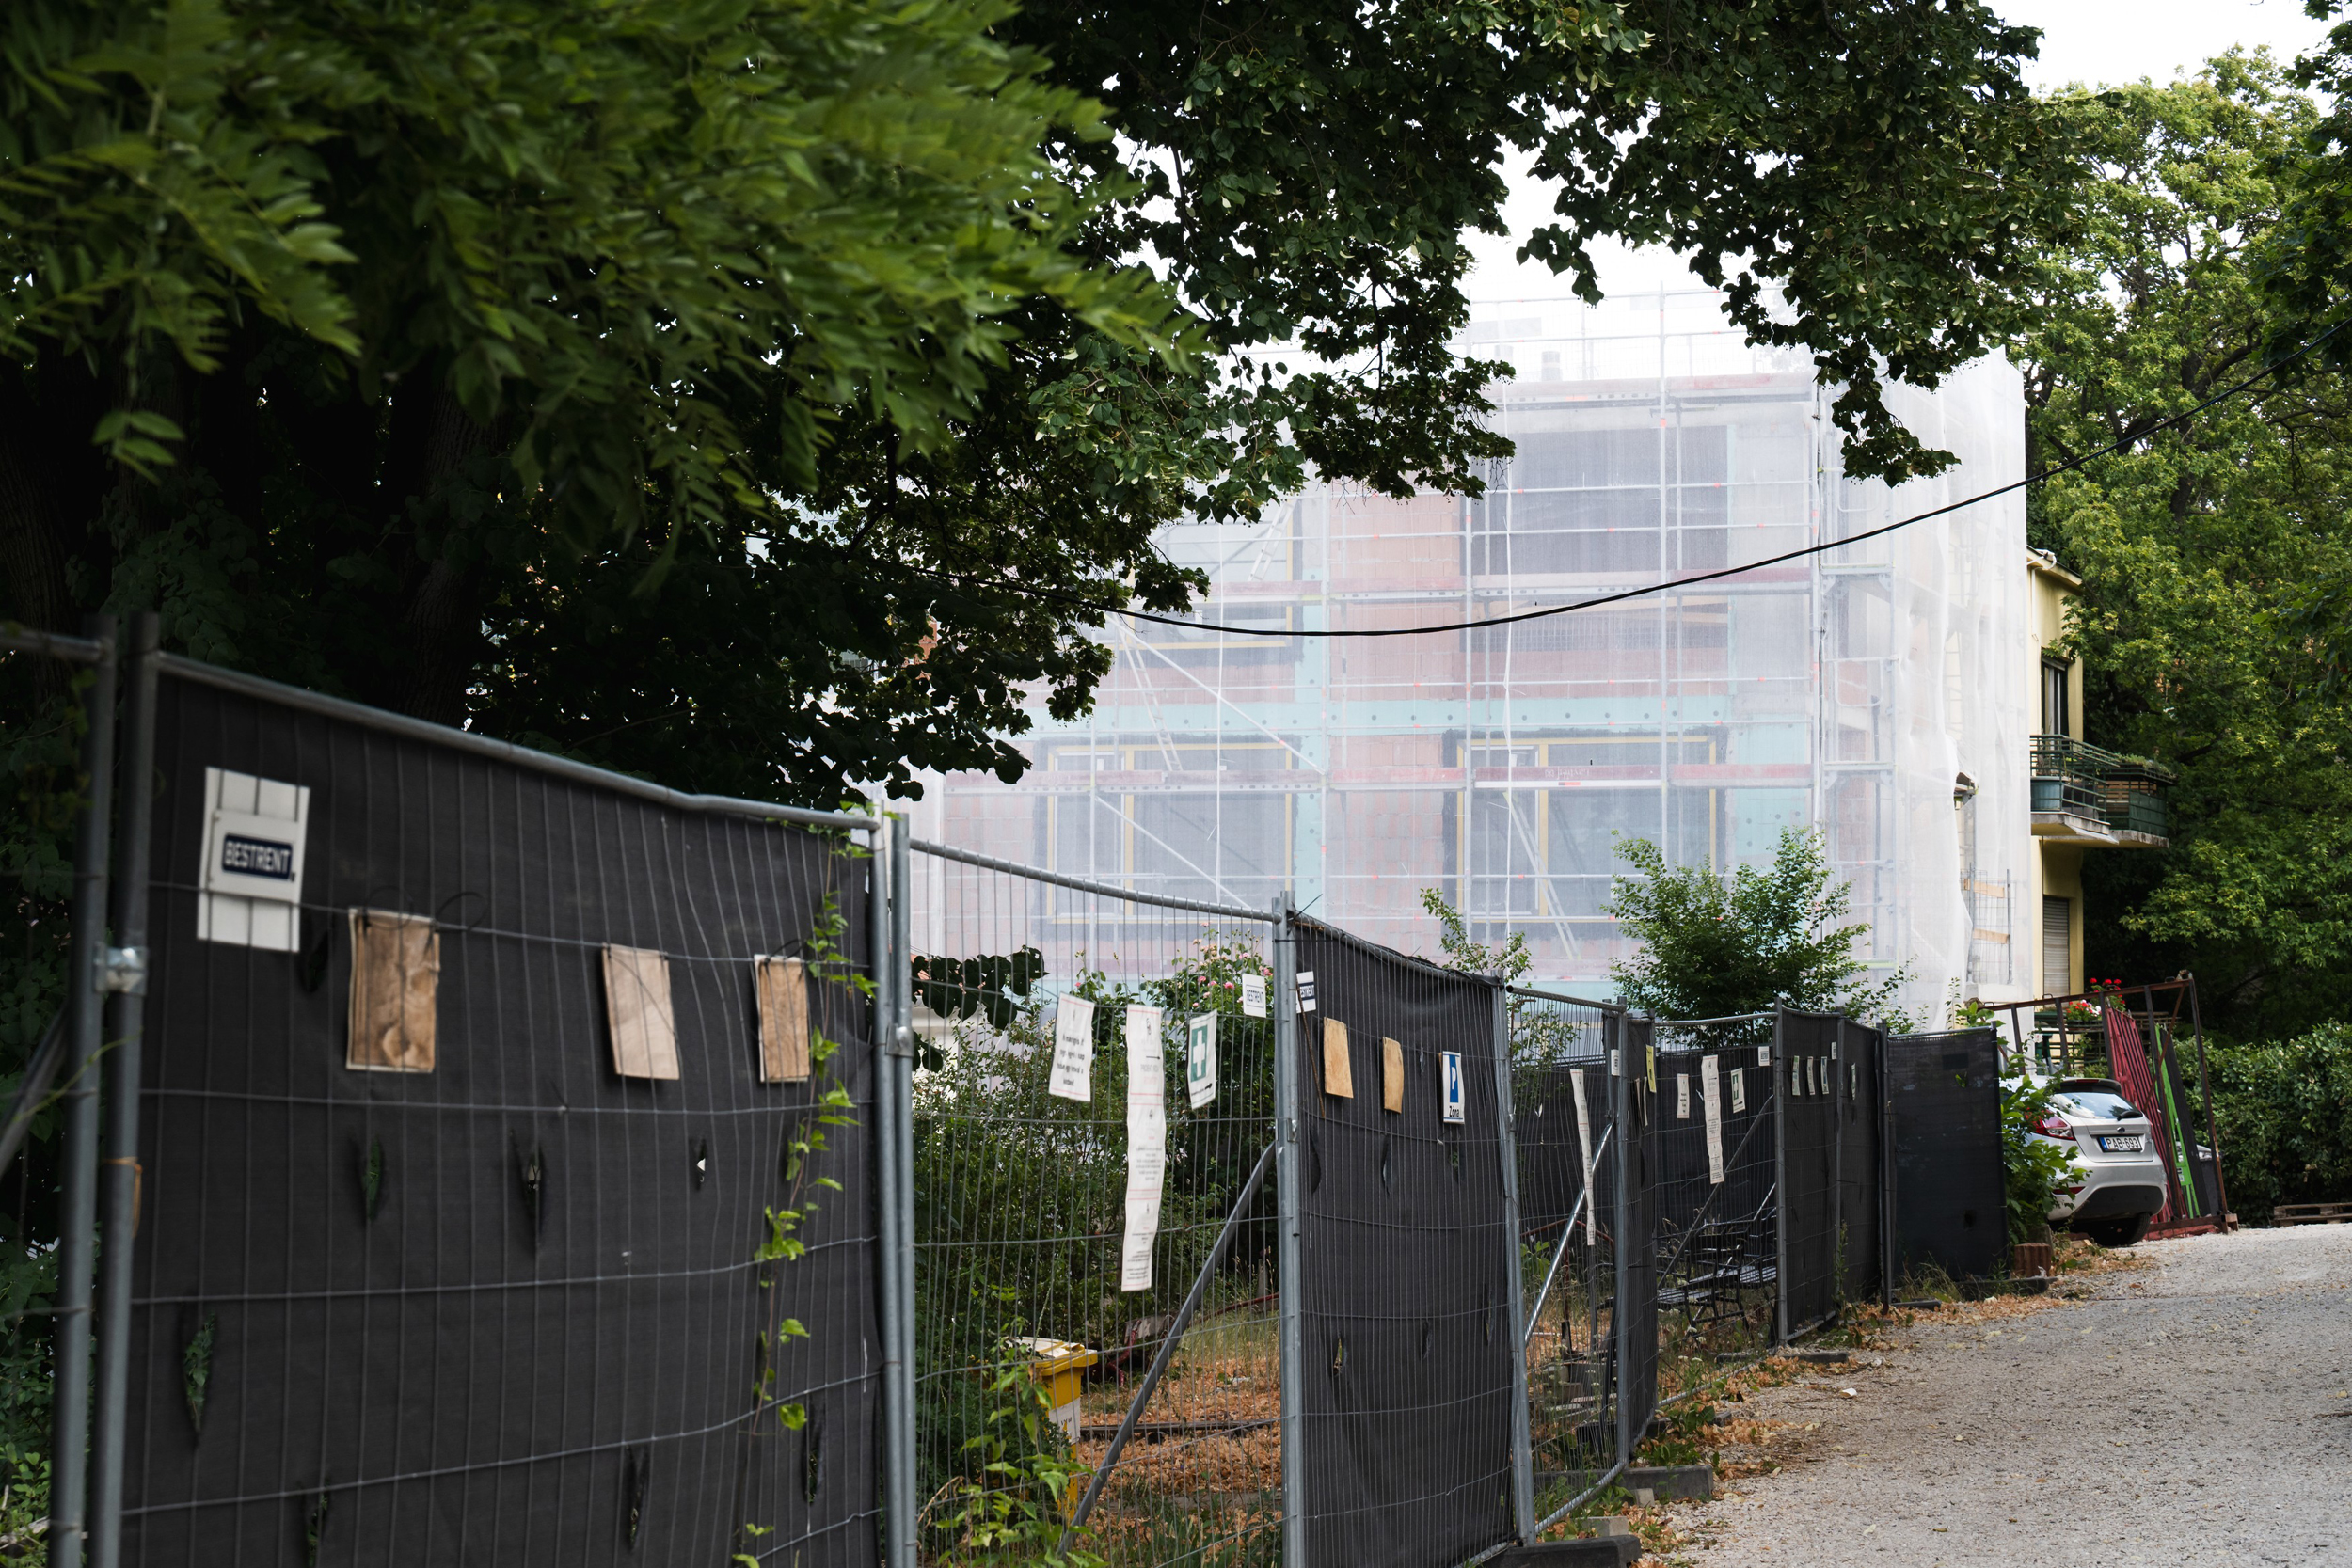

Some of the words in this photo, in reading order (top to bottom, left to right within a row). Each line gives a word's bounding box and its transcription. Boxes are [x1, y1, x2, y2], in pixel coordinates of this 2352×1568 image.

[226, 841, 291, 873] BESTRENT
[1247, 989, 1263, 1004] BESTRENT
[1299, 985, 1314, 998] ESTRENT
[1451, 1066, 1457, 1090] P
[1449, 1105, 1460, 1118] Zóna
[2106, 1137, 2139, 1148] PAB-693
